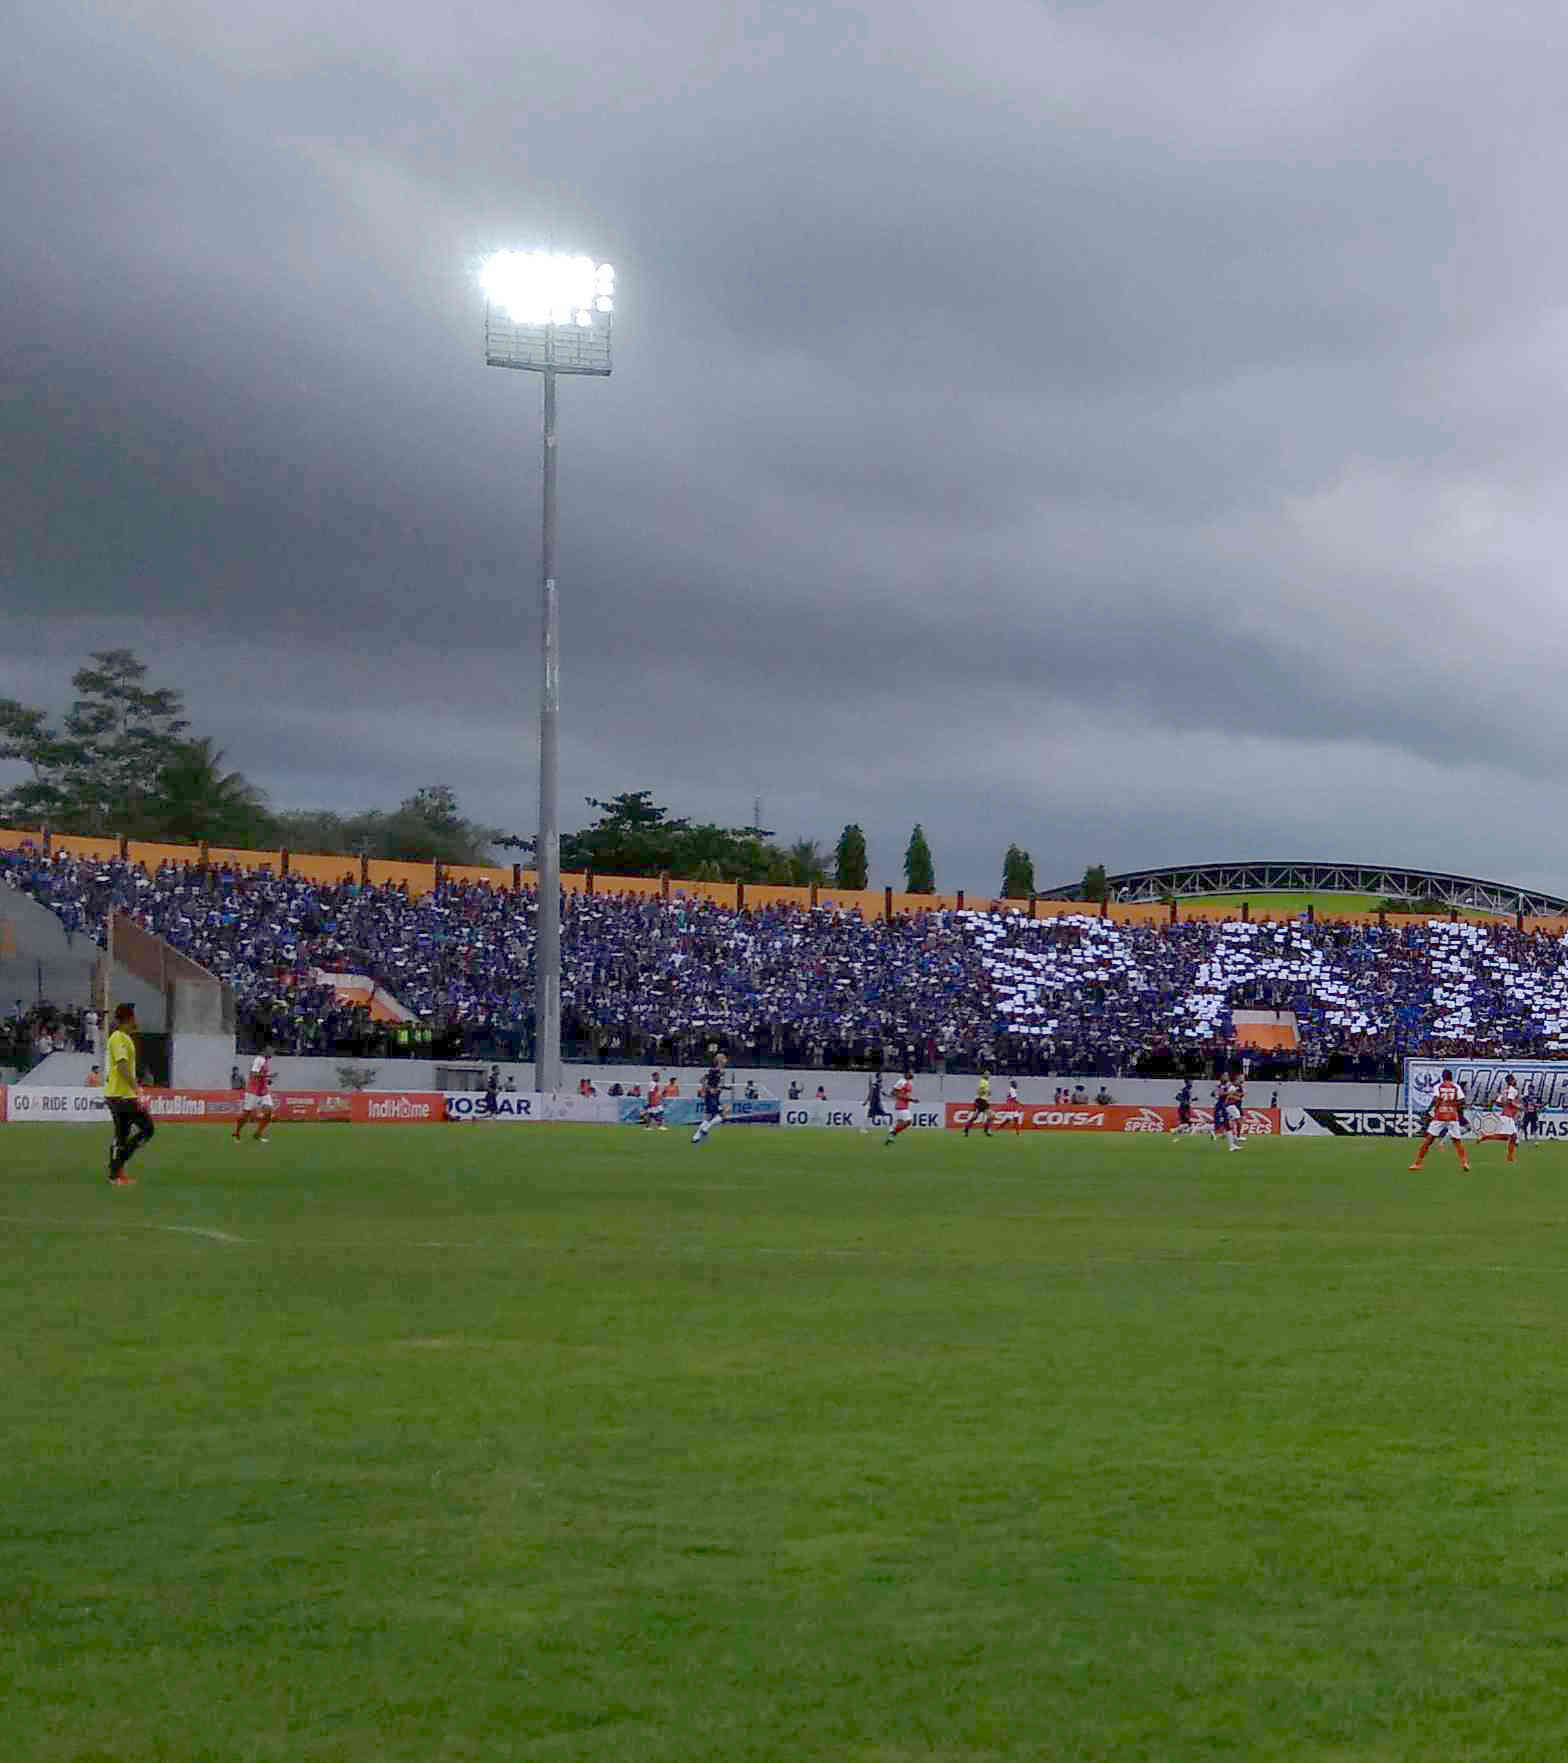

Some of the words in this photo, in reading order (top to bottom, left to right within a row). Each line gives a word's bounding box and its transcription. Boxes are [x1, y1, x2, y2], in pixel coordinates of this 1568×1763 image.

[14, 1096, 30, 1111] GO
[42, 1096, 68, 1111] RIDE
[368, 1098, 431, 1118] IndiHome
[786, 1111, 808, 1124] GO
[826, 1112, 853, 1126] JEK
[1124, 1121, 1164, 1132] SPECS
[1241, 1122, 1272, 1134] PECS
